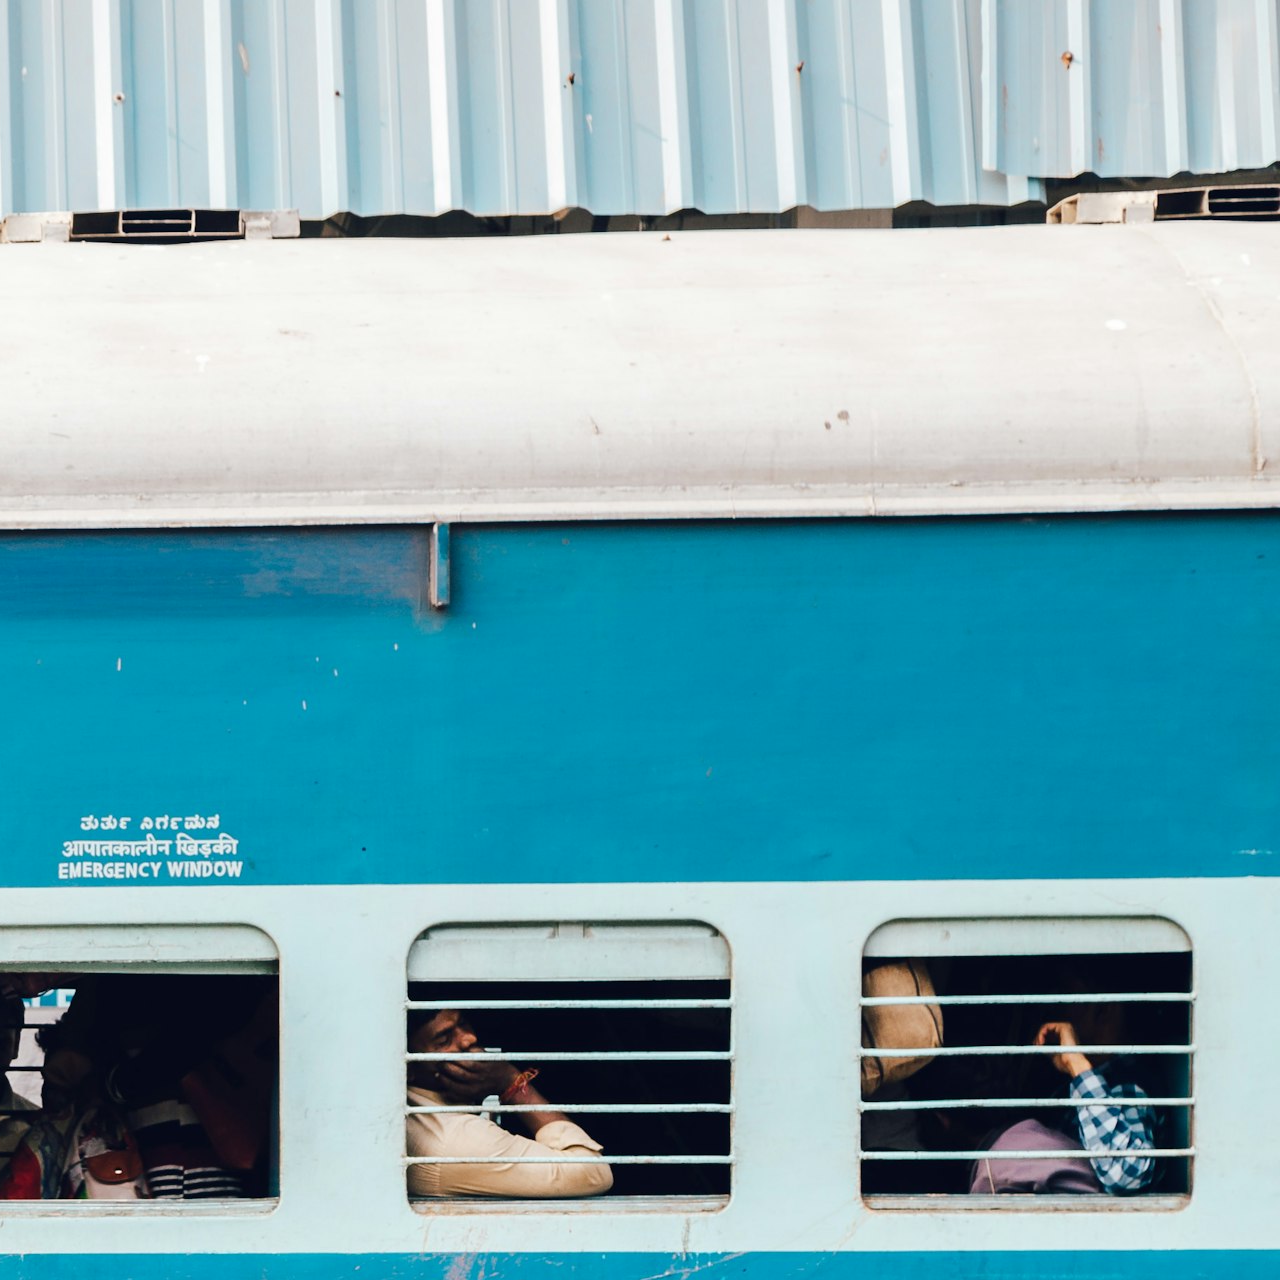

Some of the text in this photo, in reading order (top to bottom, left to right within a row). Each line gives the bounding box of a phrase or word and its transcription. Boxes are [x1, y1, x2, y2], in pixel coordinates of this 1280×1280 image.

[61, 832, 239, 858] आपातकालीन खिड़की
[58, 860, 243, 879] EMERGENCY WINDOW
